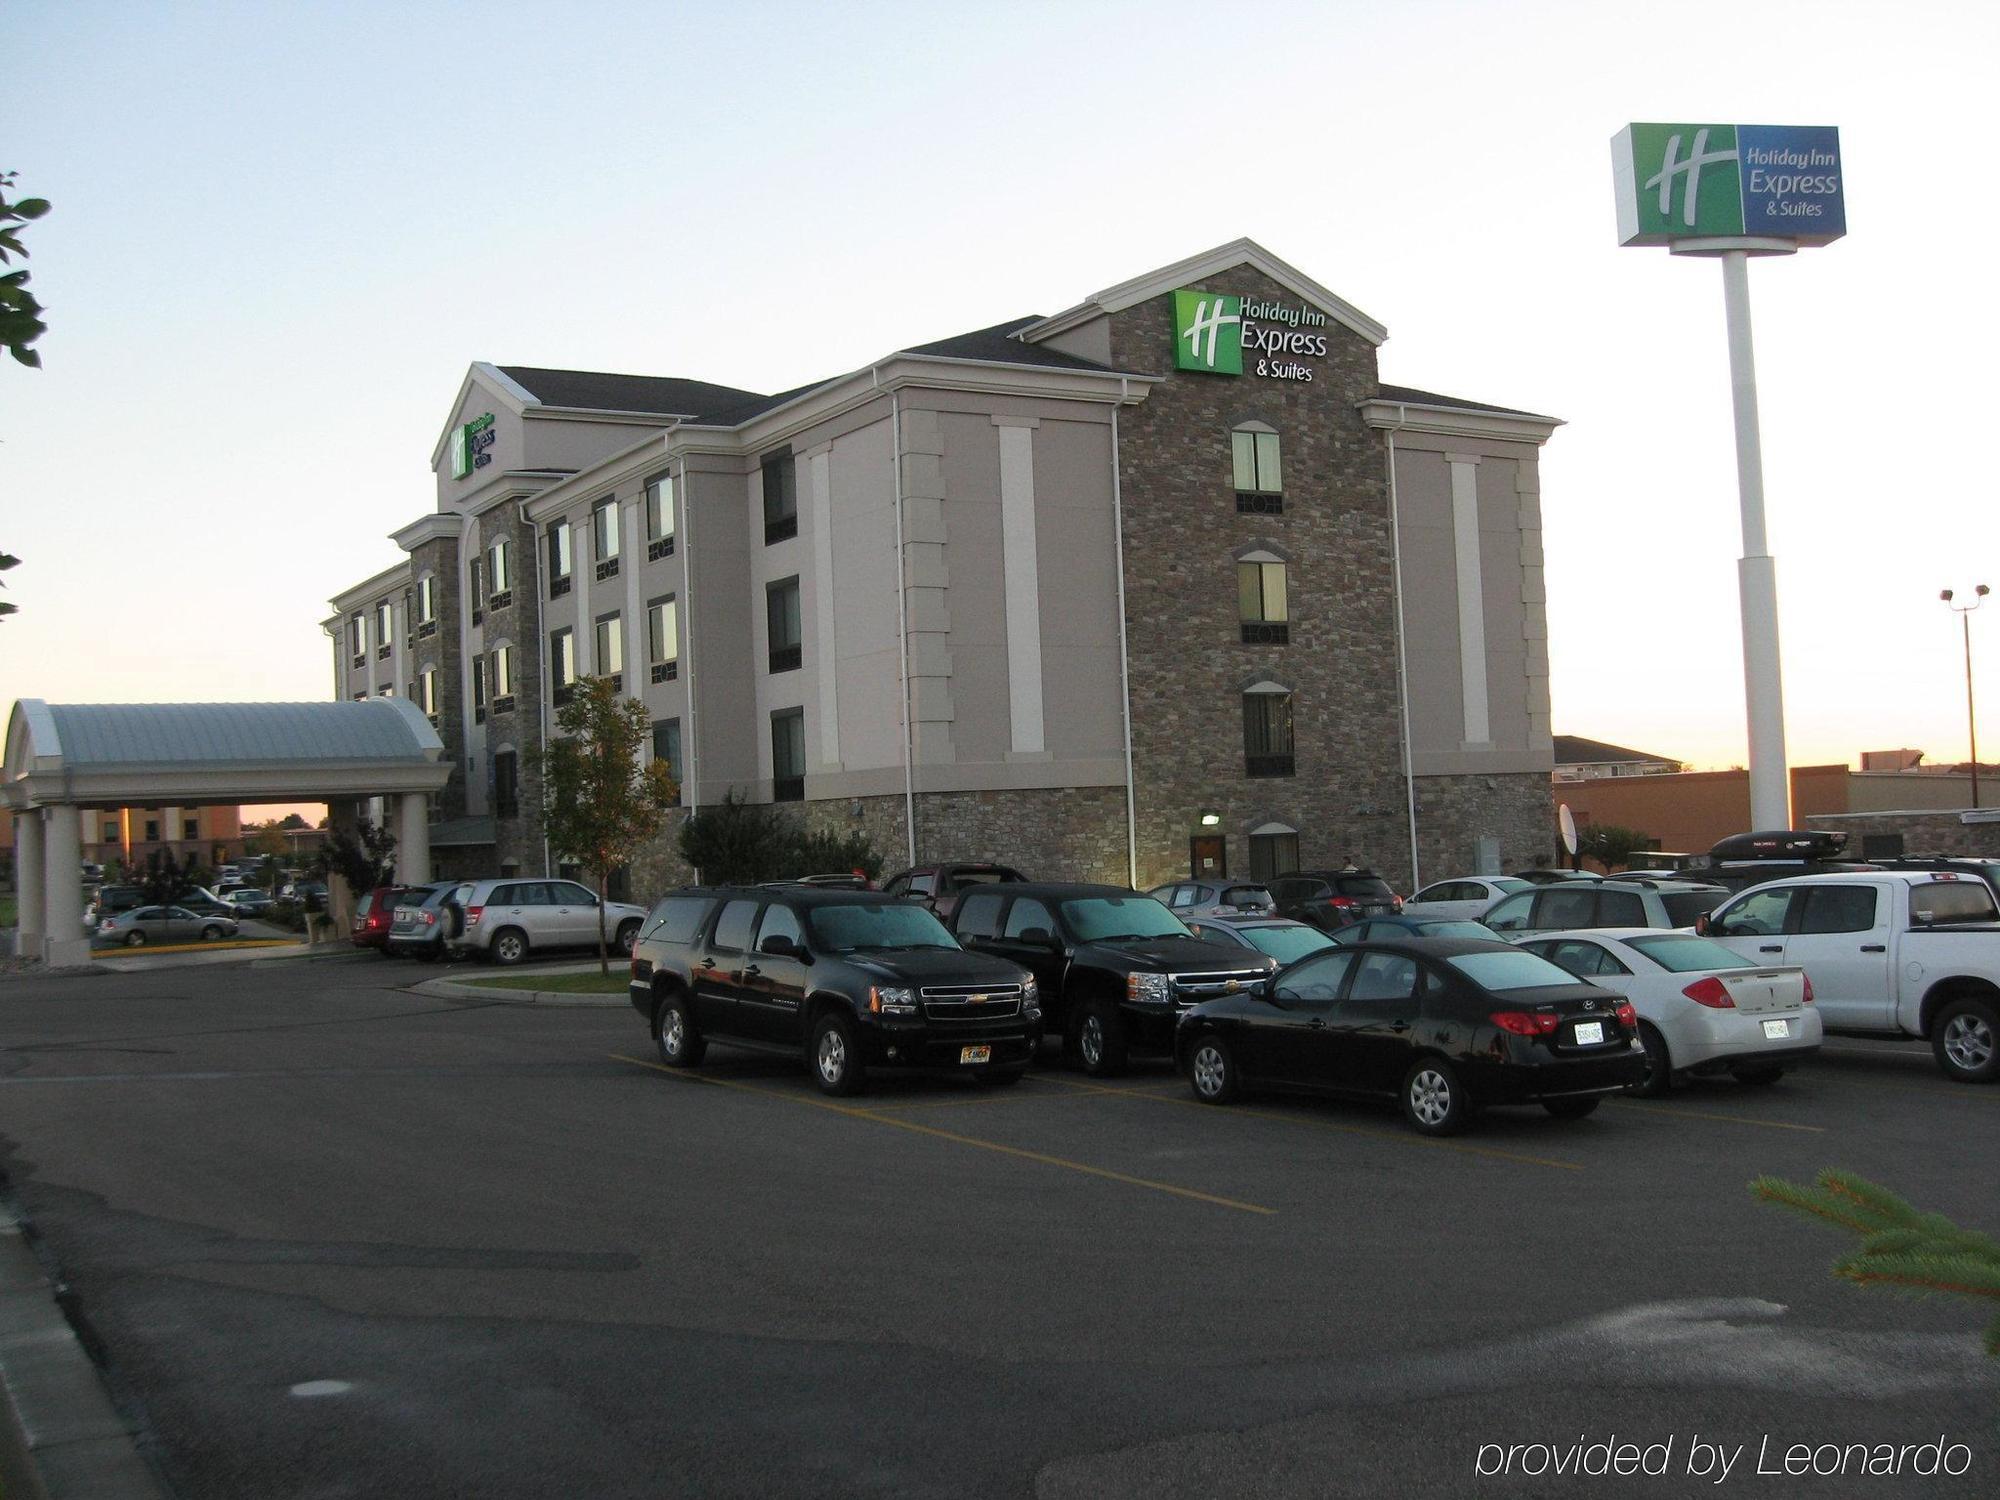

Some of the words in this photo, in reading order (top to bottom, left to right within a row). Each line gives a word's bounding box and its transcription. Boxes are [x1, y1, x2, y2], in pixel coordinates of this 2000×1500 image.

[1746, 148, 1808, 170] Holiday
[1810, 149, 1836, 166] Inn
[1749, 169, 1838, 199] Express
[1766, 202, 1778, 216] &
[1780, 201, 1824, 217] Suites
[1239, 296, 1300, 328] Holiday
[1301, 305, 1326, 327] Inn
[1240, 320, 1327, 358] Express
[1256, 359, 1268, 377] &
[1270, 360, 1313, 382] Suites
